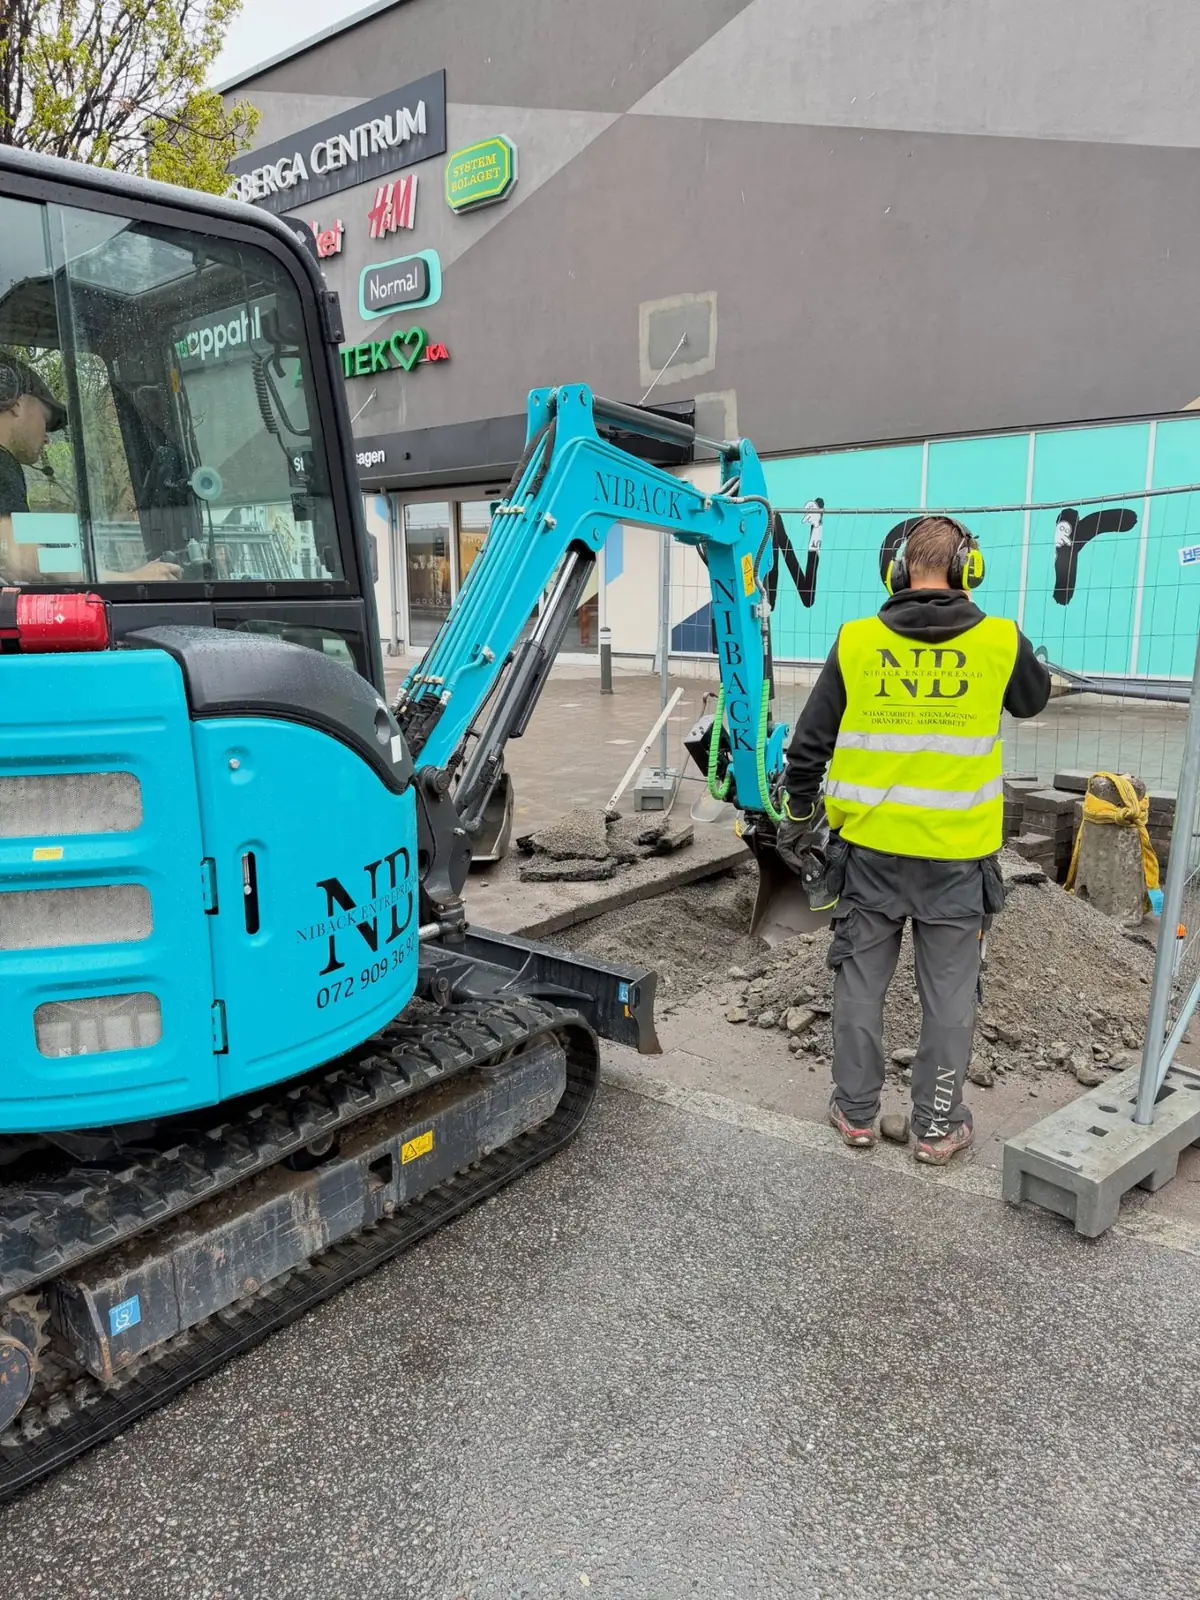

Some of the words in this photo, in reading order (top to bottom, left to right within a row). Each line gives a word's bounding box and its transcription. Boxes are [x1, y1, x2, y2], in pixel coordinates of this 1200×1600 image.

[310, 100, 427, 175] CENTRUM
[451, 167, 500, 192] BOLAGET
[453, 153, 497, 177] SYSTEM
[367, 174, 418, 239] H&M
[370, 267, 418, 300] Normal
[426, 343, 449, 361] ICA
[593, 470, 683, 521] NIBACK
[712, 577, 755, 752] NIBACK
[863, 669, 902, 678] NIBACK
[905, 669, 983, 679] ENTREPRENAD
[296, 911, 358, 944] NIBACK
[316, 976, 355, 1010] 072
[360, 957, 389, 991] 909
[391, 943, 405, 971] 36
